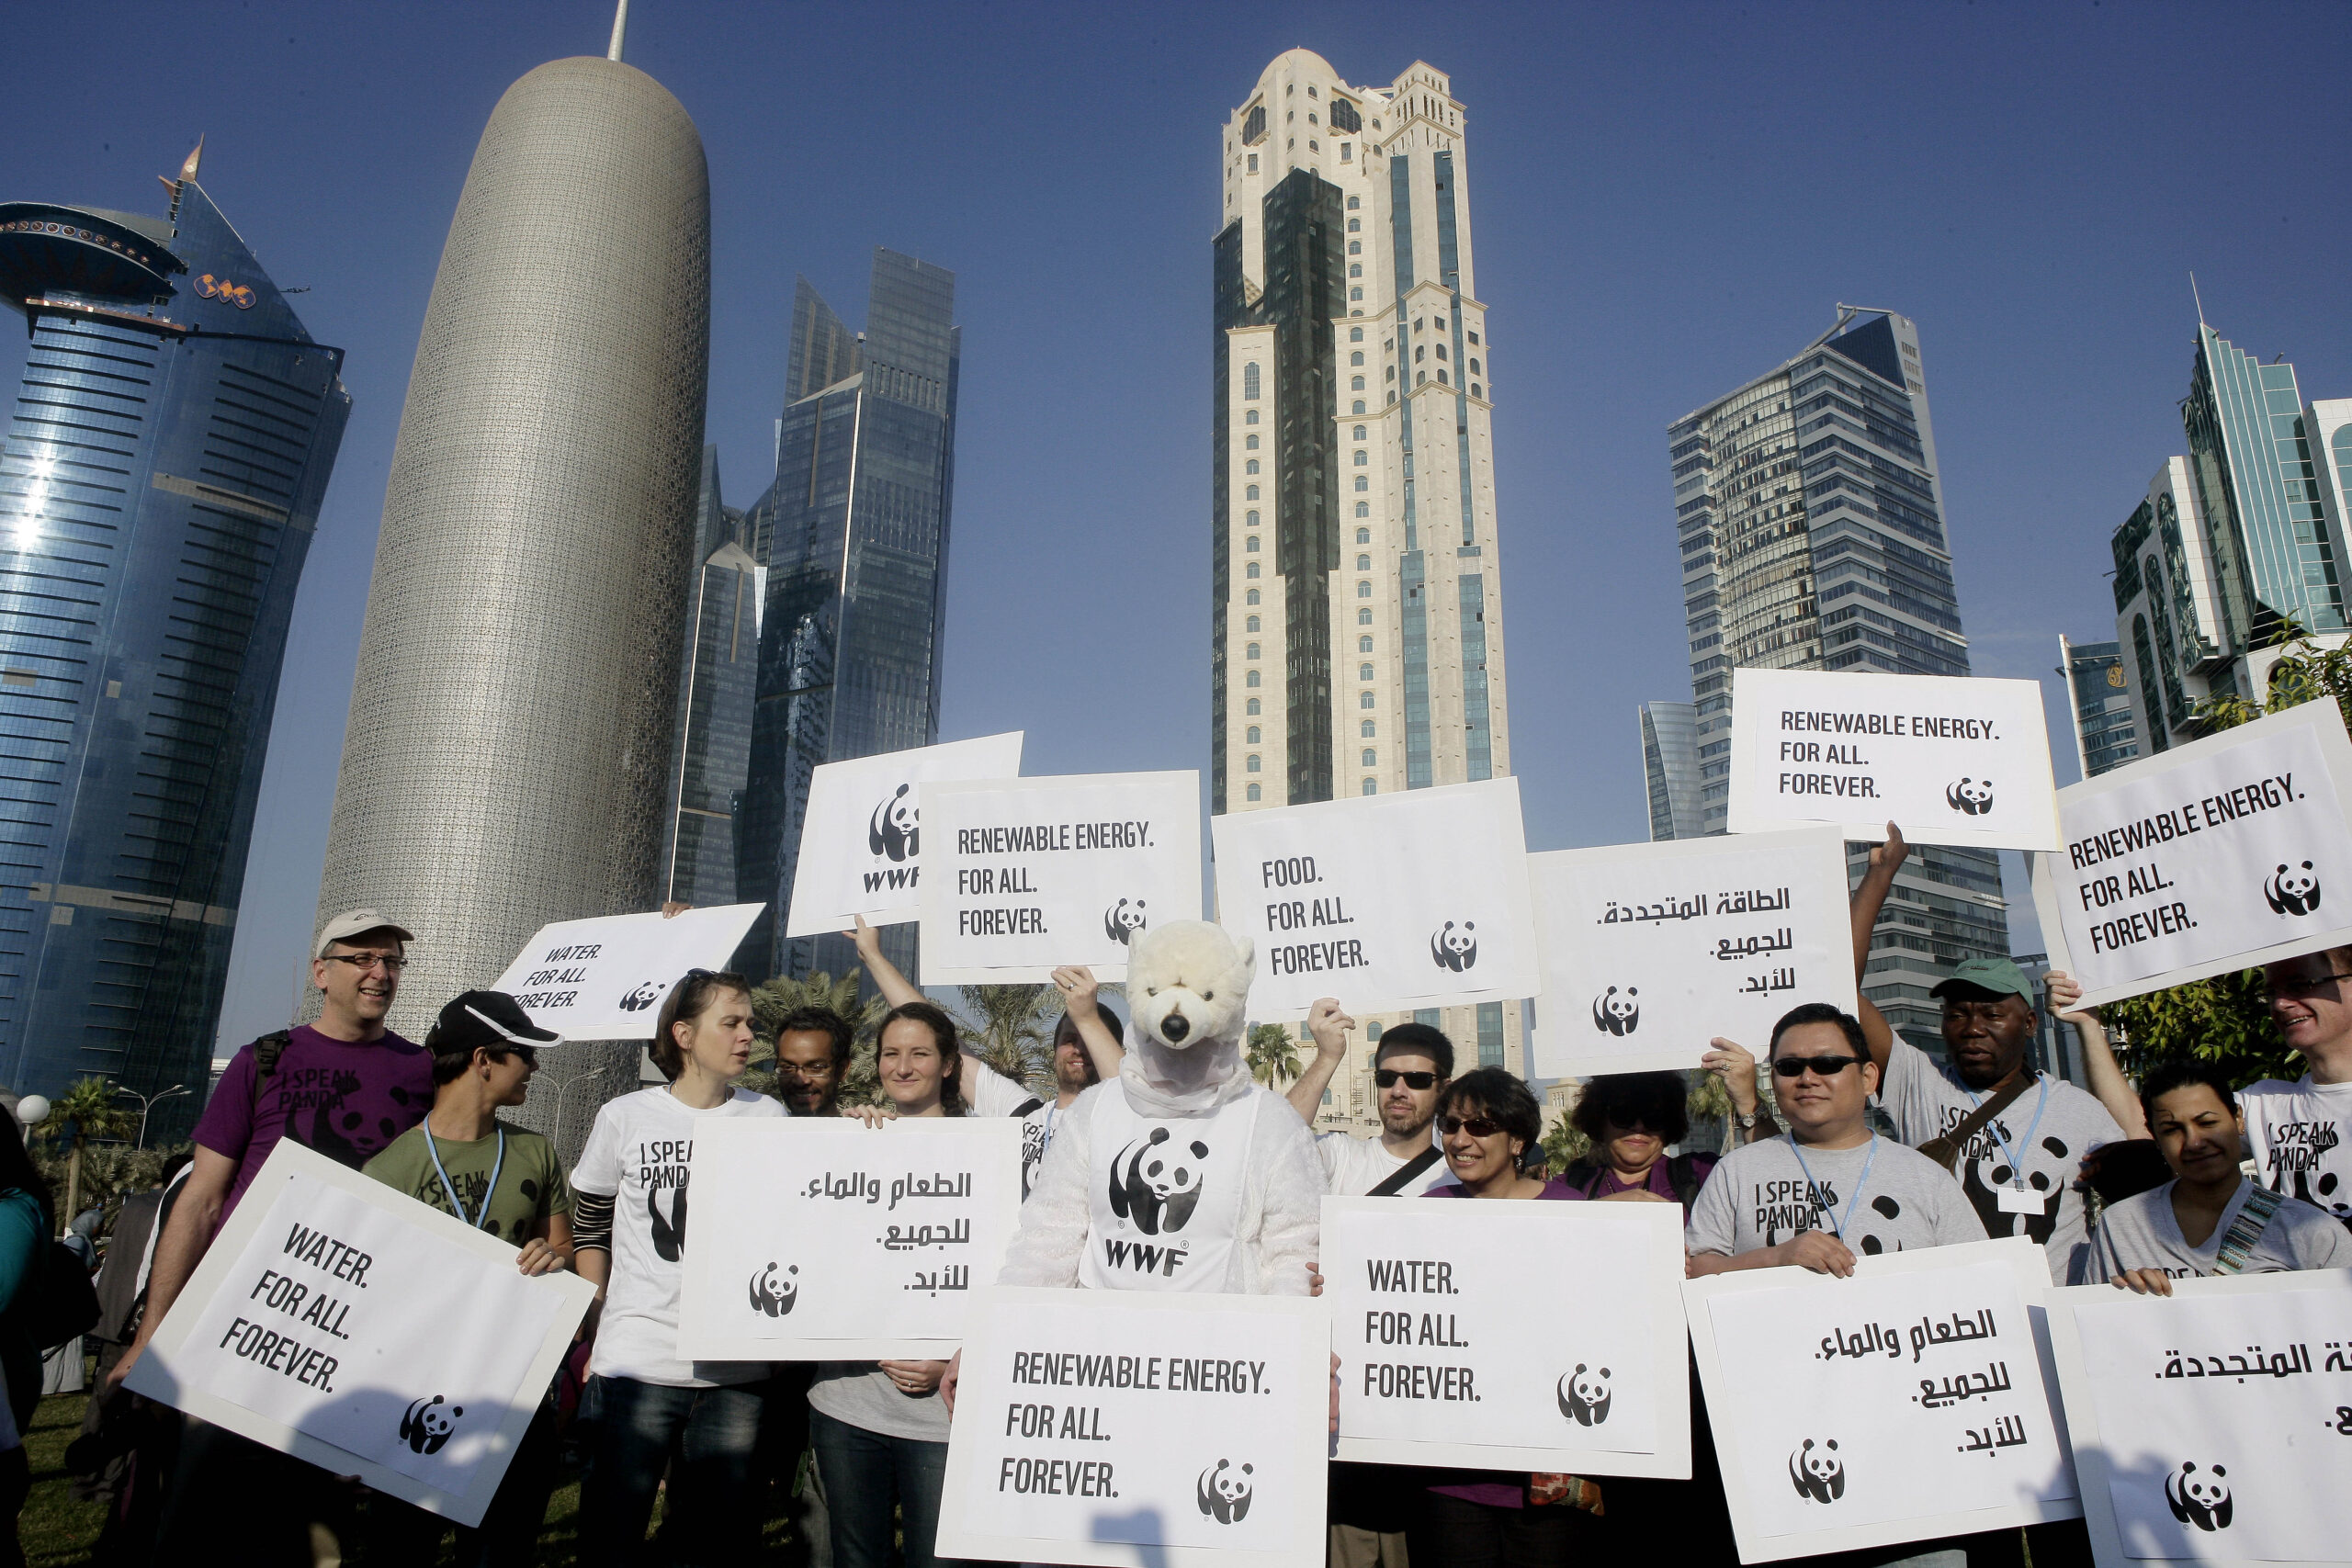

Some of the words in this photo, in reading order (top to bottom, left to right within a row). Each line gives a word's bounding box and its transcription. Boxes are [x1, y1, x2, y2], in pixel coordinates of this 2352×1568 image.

[1781, 711, 1905, 736] RENEWABLE
[1912, 716, 2000, 740] ENERGY.
[1781, 741, 1820, 762] FOR
[1826, 744, 1870, 765] ALL.
[1780, 773, 1881, 798] FOREVER.
[958, 824, 1070, 854] RENEWABLE
[1075, 820, 1154, 850] ENERGY.
[2068, 804, 2201, 871] RENEWABLE
[2200, 772, 2305, 828] ENERGY.
[863, 865, 920, 894] WWF
[958, 868, 994, 896] FOR
[999, 867, 1038, 894] ALL.
[1261, 856, 1323, 888] FOOD.
[2079, 875, 2124, 912] FOR
[2127, 863, 2175, 898] ALL.
[1266, 901, 1306, 931] FOR
[1312, 897, 1354, 927] ALL.
[1597, 894, 1708, 926] المتجددة.
[1715, 887, 1791, 915] الطاقة
[959, 908, 1048, 936] FOREVER.
[2089, 901, 2198, 954] FOREVER.
[544, 944, 603, 964] WATER.
[1271, 939, 1370, 976] FOREVER.
[1710, 927, 1792, 961] للجميع.
[523, 969, 560, 987] FOR
[553, 967, 586, 984] ALL.
[1738, 967, 1796, 998] للأبد.
[291, 1068, 357, 1089] SPEAK
[277, 1089, 345, 1111] PANDA
[2274, 1121, 2336, 1145] SPEAK
[639, 1142, 647, 1165] I
[2266, 1146, 2320, 1172] PANDA
[800, 1171, 881, 1204] والماء.
[888, 1172, 971, 1212] الطعام
[1754, 1183, 1761, 1206] I
[1765, 1180, 1834, 1204] SPEAK
[876, 1218, 970, 1251] للجميع.
[1755, 1203, 1824, 1234] PANDA
[283, 1222, 373, 1289] WATER.
[1105, 1238, 1189, 1277] WWF
[904, 1265, 968, 1298] للأبد.
[1367, 1259, 1459, 1295] WATER.
[249, 1269, 309, 1317] FOR
[300, 1293, 351, 1340] ALL.
[1365, 1311, 1412, 1346] FOR
[1418, 1313, 1469, 1348] ALL.
[1815, 1322, 1902, 1361] والماء.
[1909, 1308, 1997, 1364] الطعام
[219, 1316, 339, 1393] FOREVER.
[2154, 1343, 2312, 1384] المتجددة.
[1012, 1351, 1162, 1390] RENEWABLE
[1168, 1358, 1271, 1394] ENERGY.
[1364, 1363, 1481, 1402] FOREVER.
[1911, 1361, 2012, 1409] للجميع.
[1006, 1403, 1055, 1438] FOR
[1059, 1406, 1111, 1441] ALL.
[1957, 1415, 2028, 1458] للأبد.
[999, 1457, 1119, 1498] FOREVER.
